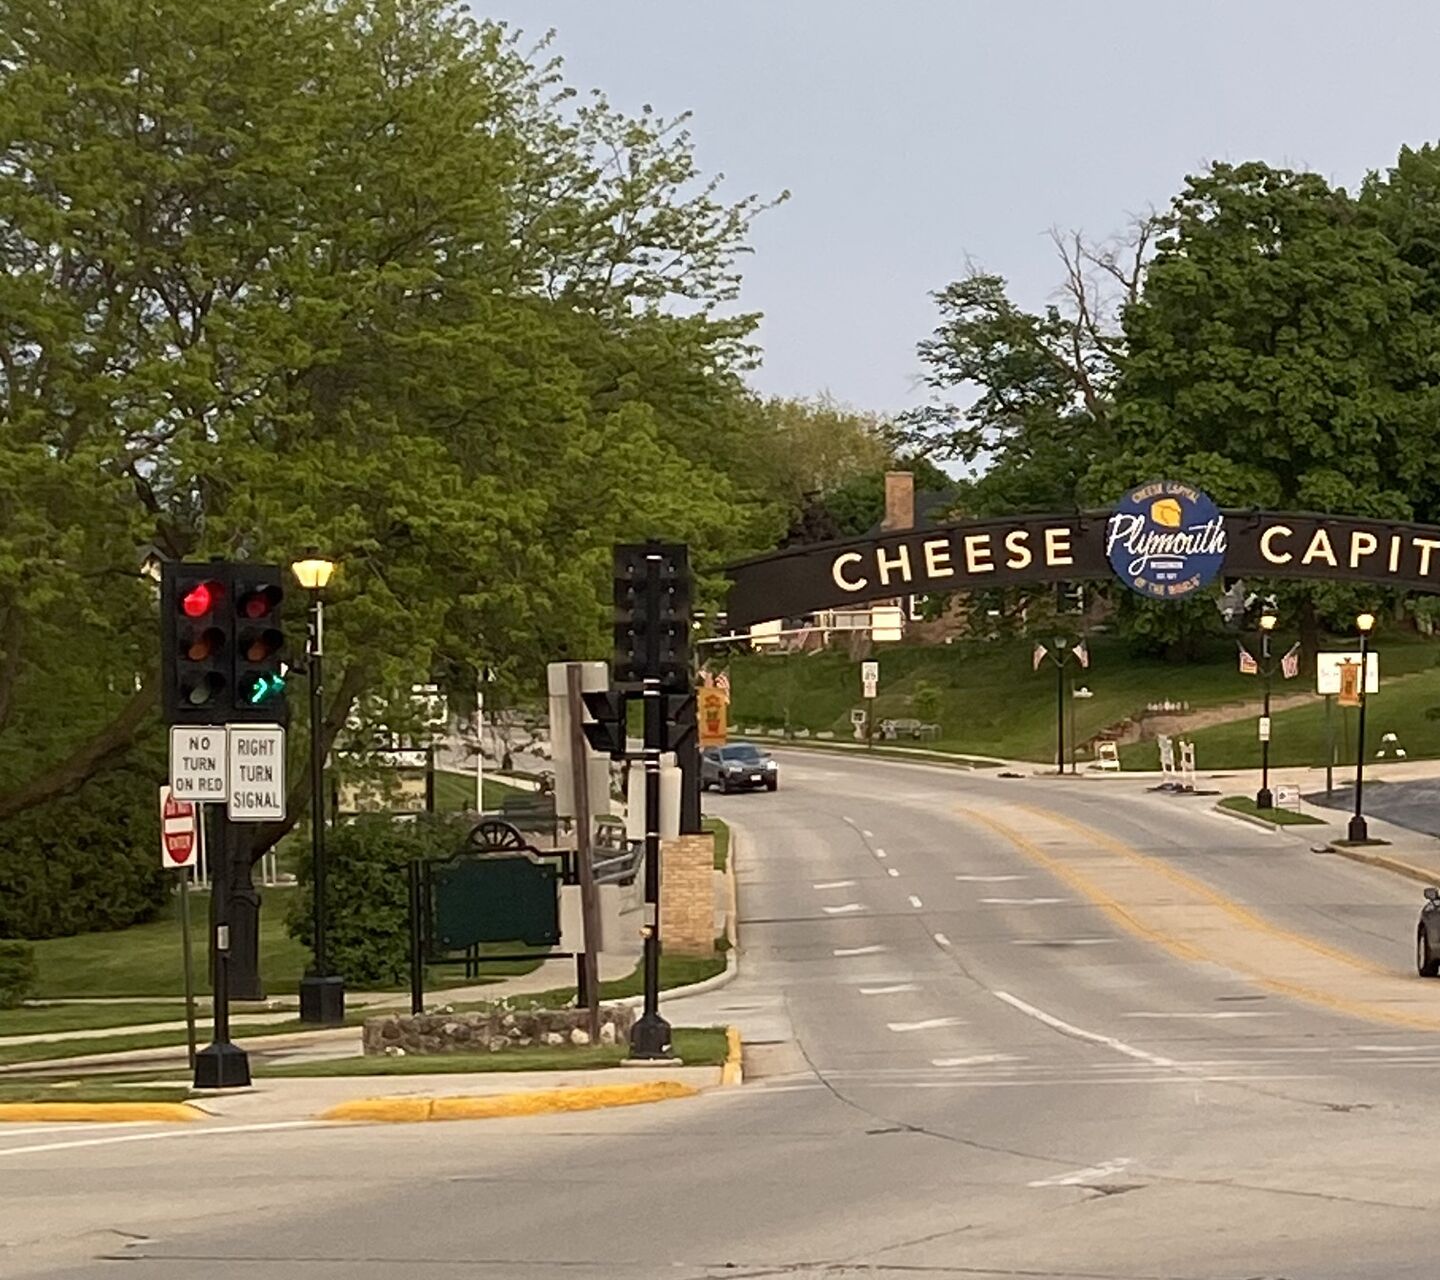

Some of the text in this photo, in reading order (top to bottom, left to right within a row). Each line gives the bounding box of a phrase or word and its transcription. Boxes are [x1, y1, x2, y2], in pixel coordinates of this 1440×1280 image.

[1106, 514, 1228, 576] Plymouth
[832, 528, 1073, 592] CHEESE
[189, 736, 210, 751] NO
[237, 738, 276, 757] RIGHT
[182, 756, 216, 771] TURN
[239, 765, 273, 783] TURN
[176, 777, 223, 792] ON RED
[233, 791, 280, 809] SIGNAL
